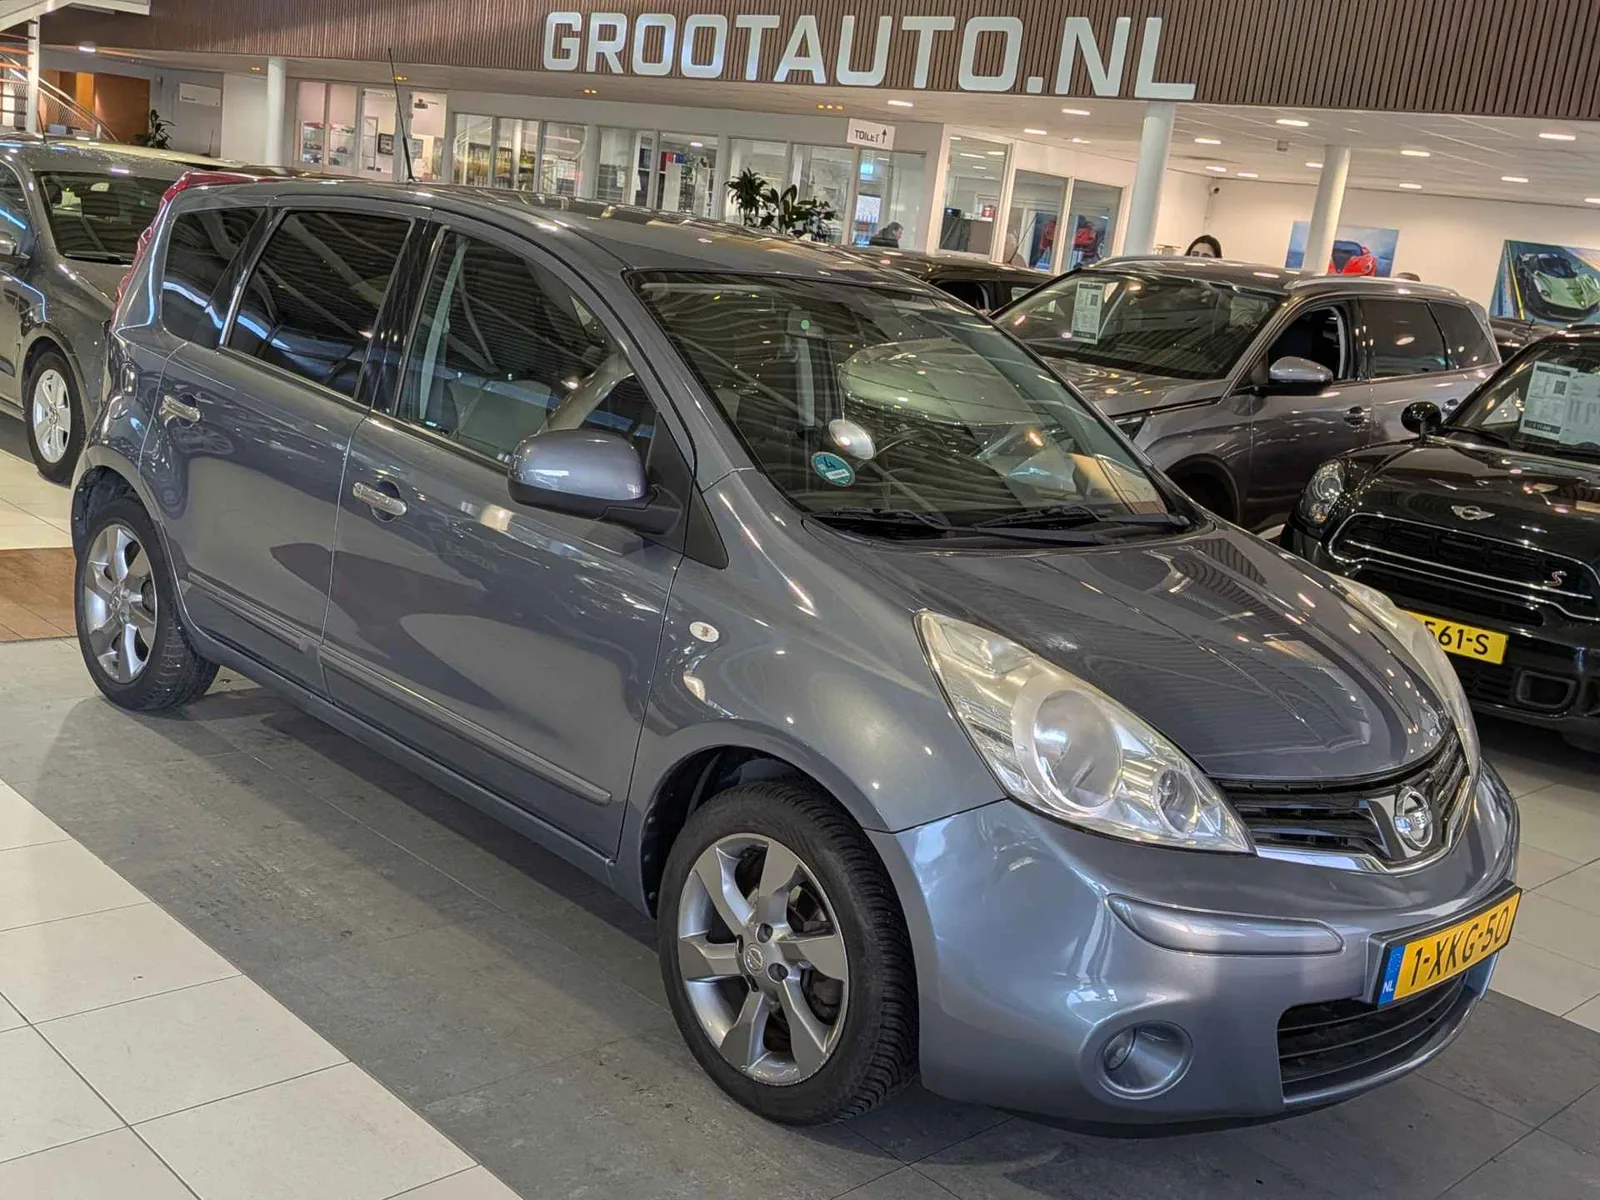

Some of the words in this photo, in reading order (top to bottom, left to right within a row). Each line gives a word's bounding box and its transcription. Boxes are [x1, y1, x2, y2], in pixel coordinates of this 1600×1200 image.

[543, 11, 1197, 99] GROOTAUTO.NL
[854, 129, 881, 143] TOILET
[1410, 906, 1509, 987] 1-XKG-50
[1382, 981, 1394, 994] NL
